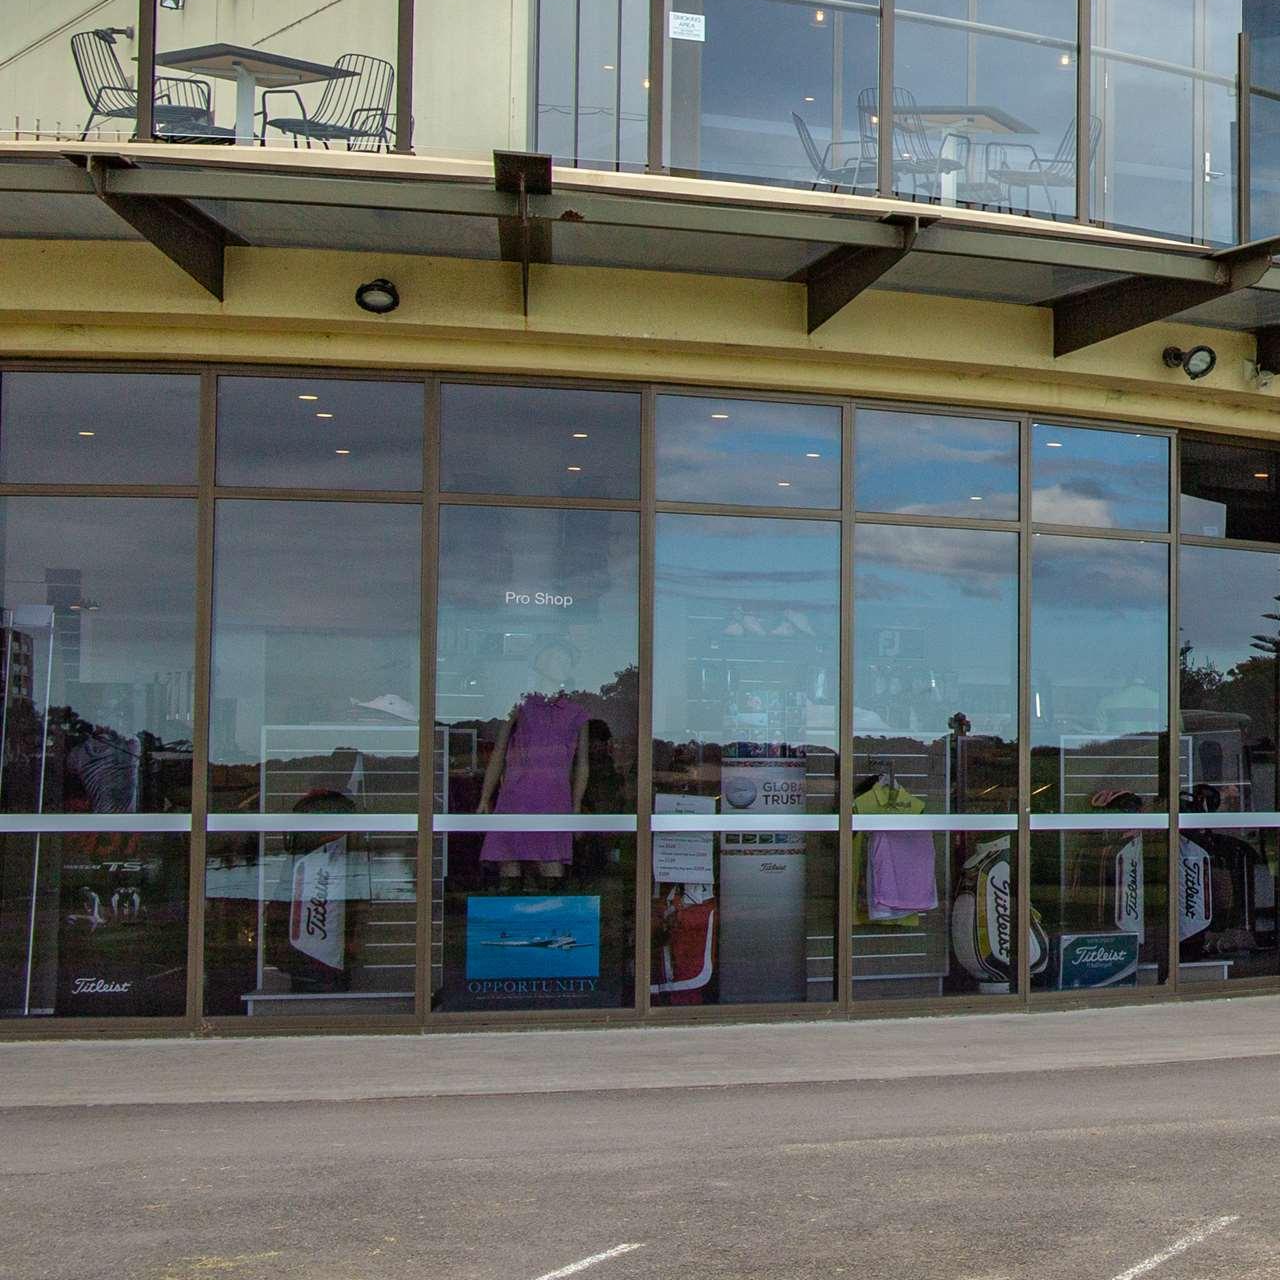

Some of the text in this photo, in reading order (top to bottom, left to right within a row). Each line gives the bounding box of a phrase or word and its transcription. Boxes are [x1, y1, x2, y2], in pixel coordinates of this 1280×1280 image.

[505, 591, 573, 609] Pro Shop
[306, 867, 330, 941] Titleist
[1125, 859, 1139, 920] Titleist
[1183, 858, 1201, 920] Titleist
[990, 875, 1011, 959] Titleist
[1071, 944, 1128, 965] Titleist
[71, 977, 132, 995] Titleist
[468, 979, 598, 994] OPPORTUNITY
